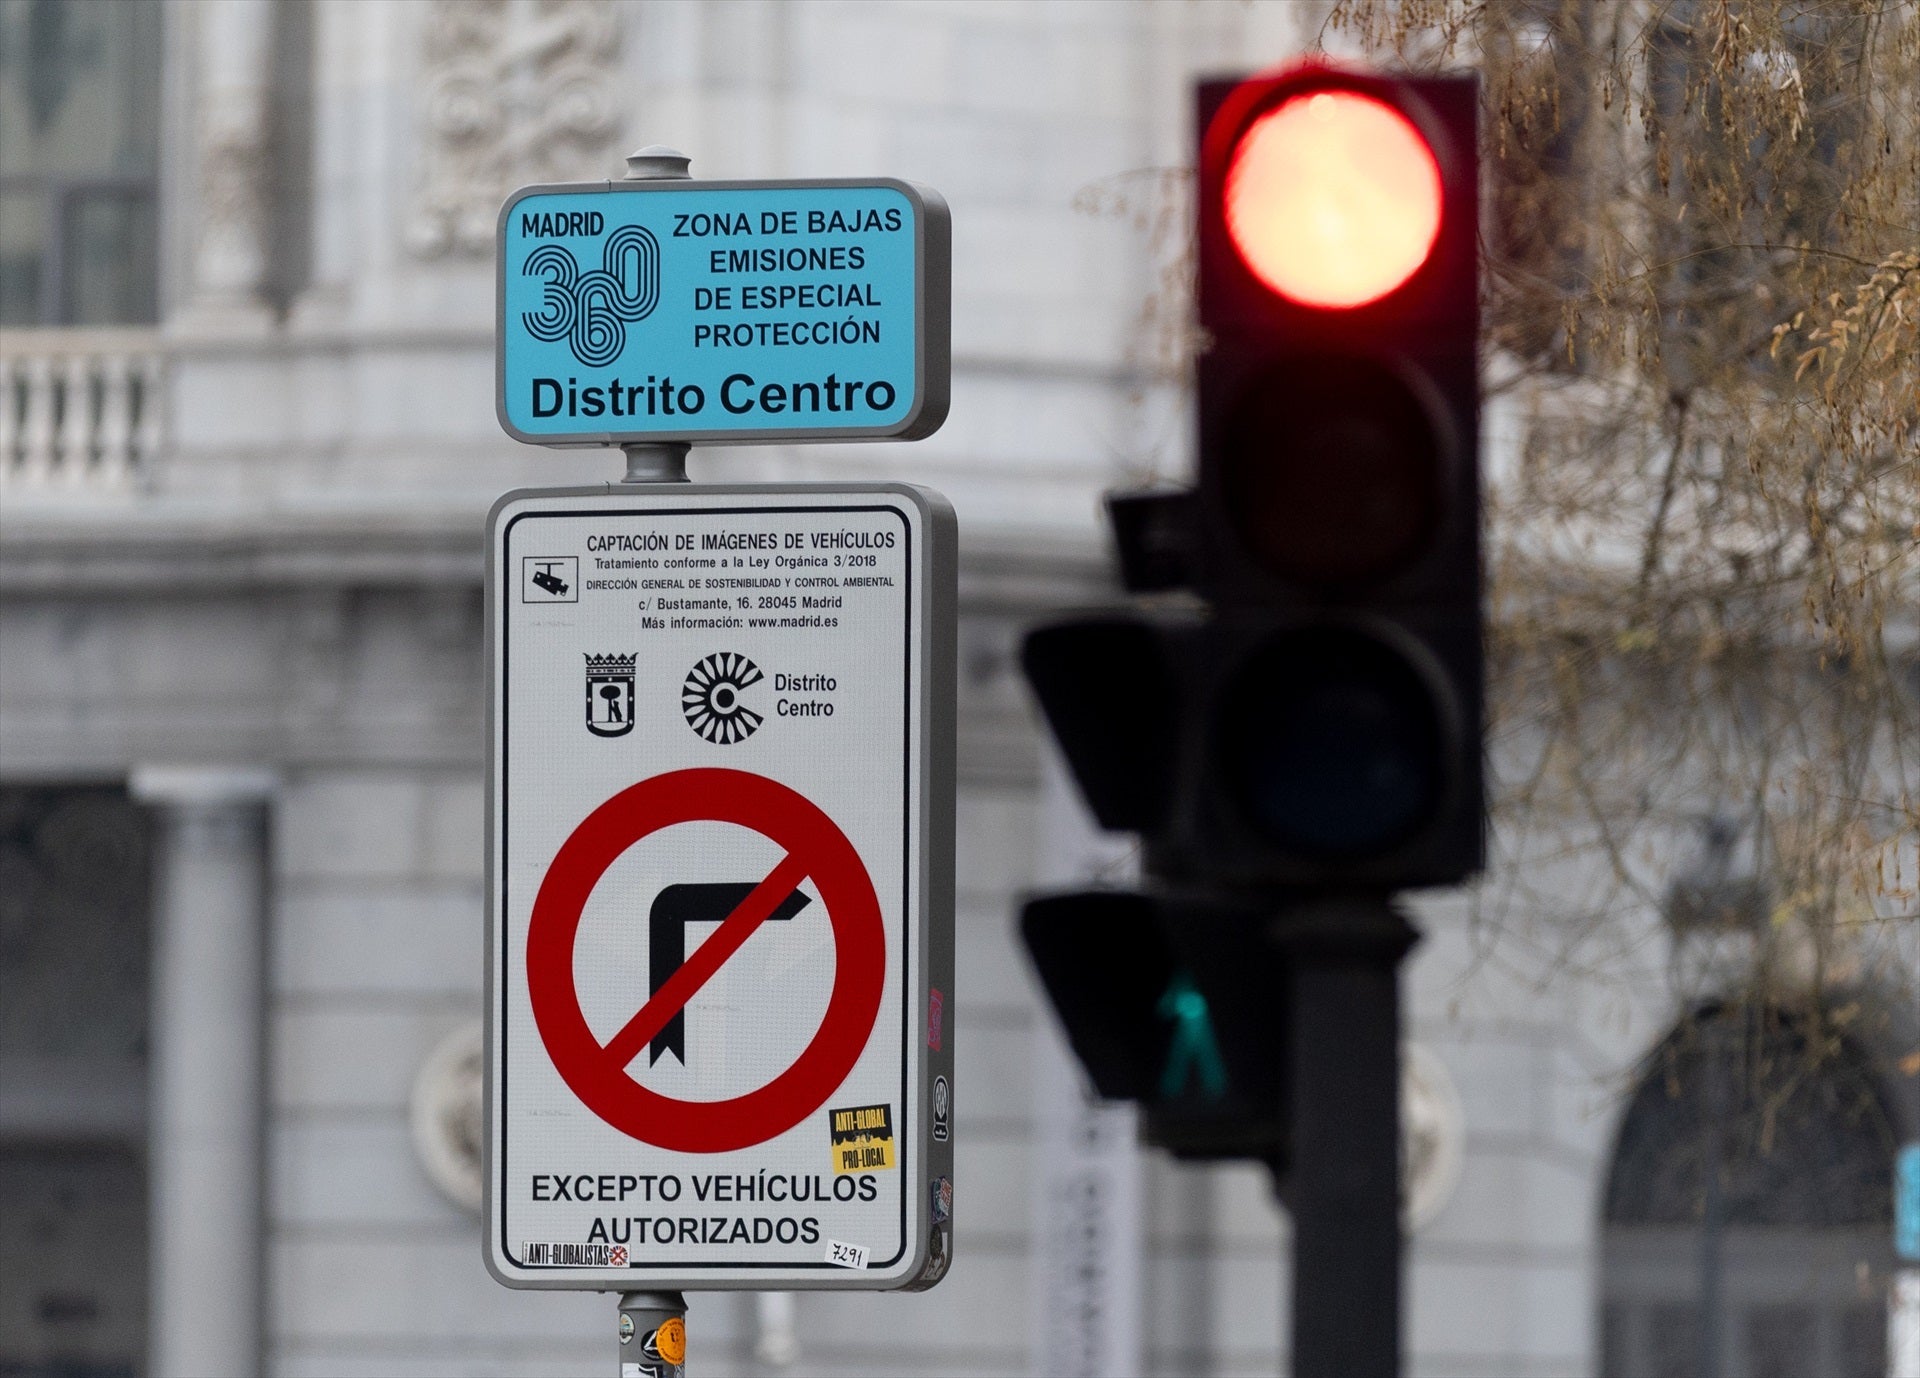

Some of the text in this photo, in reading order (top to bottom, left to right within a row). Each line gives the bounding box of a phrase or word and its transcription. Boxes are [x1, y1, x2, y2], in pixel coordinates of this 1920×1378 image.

[523, 212, 604, 238] MADRID
[673, 209, 901, 237] ZONA DE BAJAS
[711, 247, 864, 273] EMISIONES
[695, 284, 881, 310] DE ESPECIAL
[695, 315, 879, 347] PROTECCIÓN
[533, 373, 895, 417] Distrito Centro
[587, 529, 894, 551] CAPTACIÓN DE IMÁGENES DE VEHÍCULOS
[595, 555, 876, 569] Tratamiento conforme a la Ley Orgánica 3/2018
[587, 577, 894, 590] DIRECCIÓN GENERAL DE SOSTENIBILIDAD Y CONTROL AMBIENTAL
[639, 596, 841, 612] c/ Bustamante, 16. 28045 Madrid
[642, 616, 838, 629] Más información: www.madrid.es
[775, 674, 836, 691] Distrito
[777, 699, 833, 716] Centro
[836, 1108, 886, 1132] ANTI-GLOBAL
[842, 1147, 886, 1169] PRO-LOCAL
[533, 1169, 877, 1202] EXCEPTO VEHÍCULOS
[587, 1217, 820, 1244] AUTORIZADOS
[528, 1243, 609, 1266] ANTI-GLOBALISTAS
[833, 1244, 861, 1267] 7291
